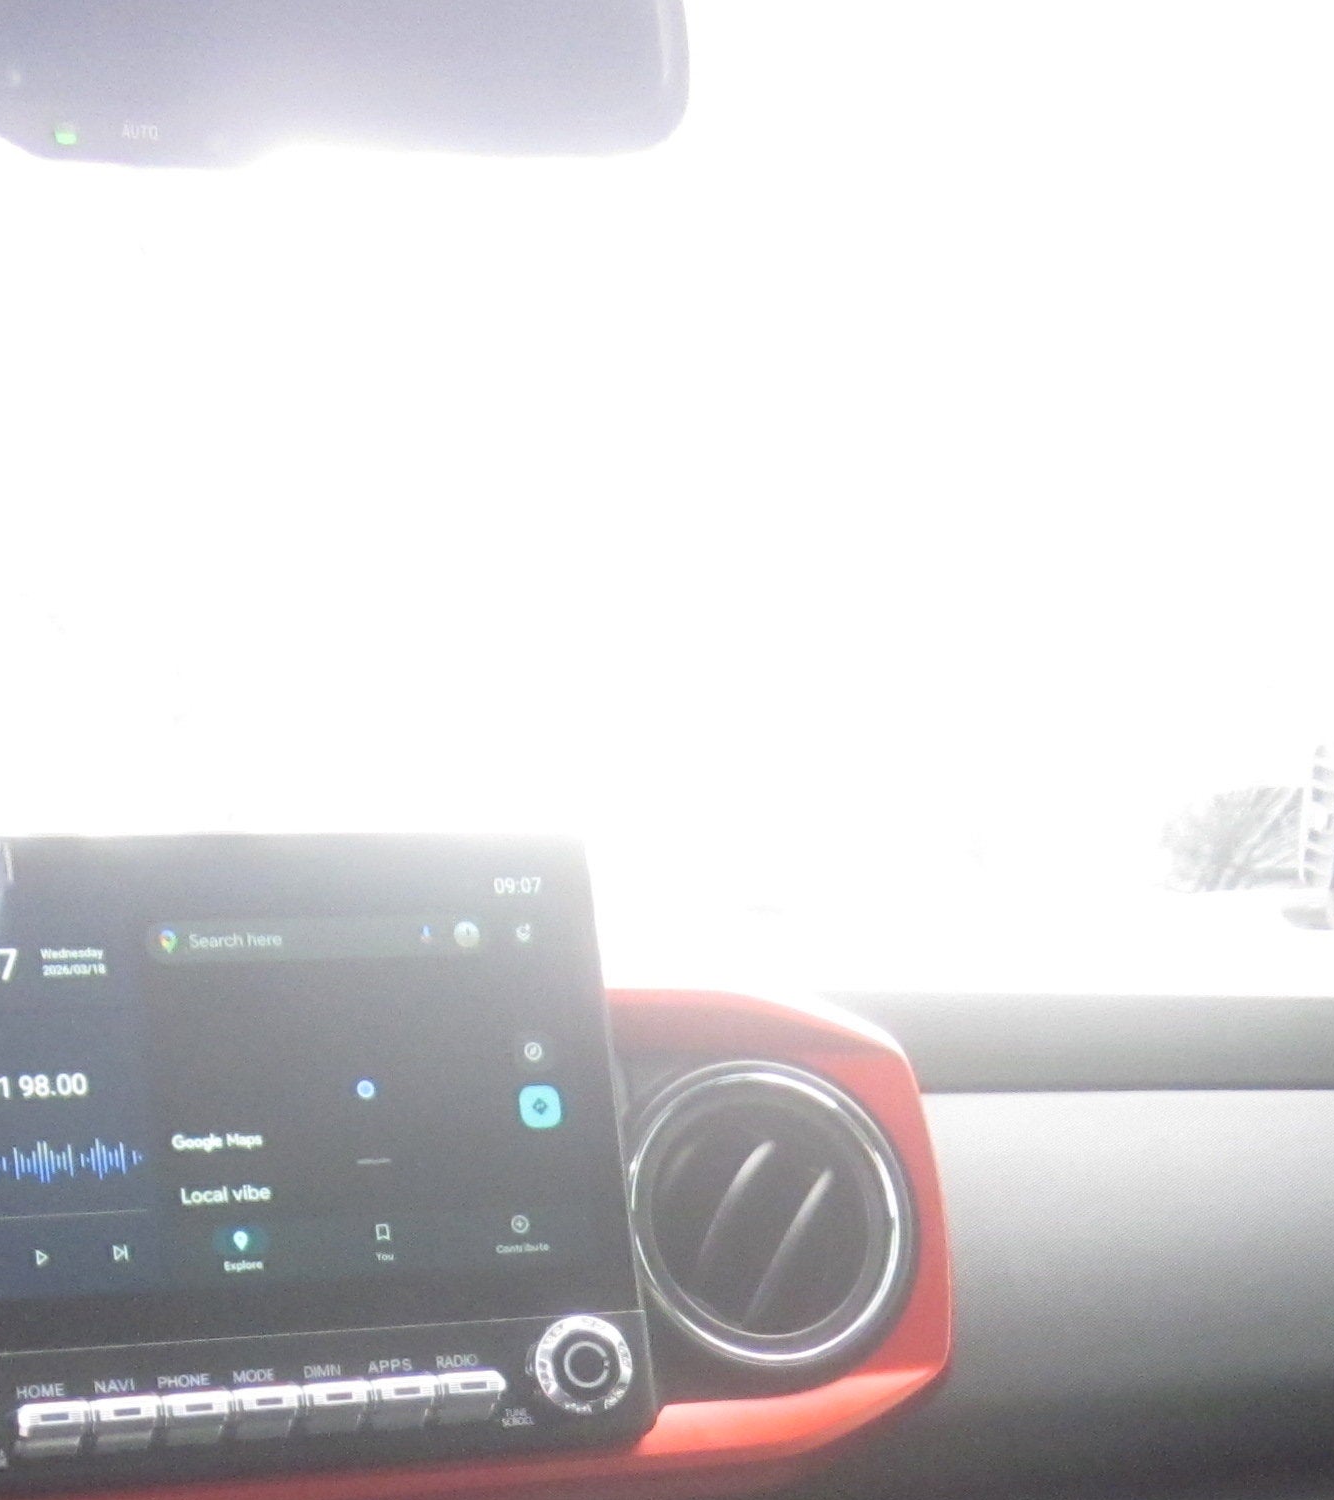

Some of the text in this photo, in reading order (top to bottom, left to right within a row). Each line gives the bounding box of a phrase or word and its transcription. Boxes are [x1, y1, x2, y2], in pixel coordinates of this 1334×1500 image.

[121, 123, 159, 141] AUTO
[493, 876, 542, 895] 09:07
[188, 930, 283, 950] Search here
[39, 946, 104, 961] Wednesday
[18, 1071, 89, 1098] 98.00
[171, 1132, 264, 1153] Google Maps
[180, 1182, 272, 1206] Local vibe
[223, 1258, 264, 1273] Explore
[368, 1358, 414, 1375] APPS
[435, 1353, 479, 1370] RADIO
[156, 1372, 211, 1389] PHONE
[232, 1367, 275, 1384] MODE
[16, 1382, 65, 1400] HOME
[93, 1378, 137, 1394] NAVI
